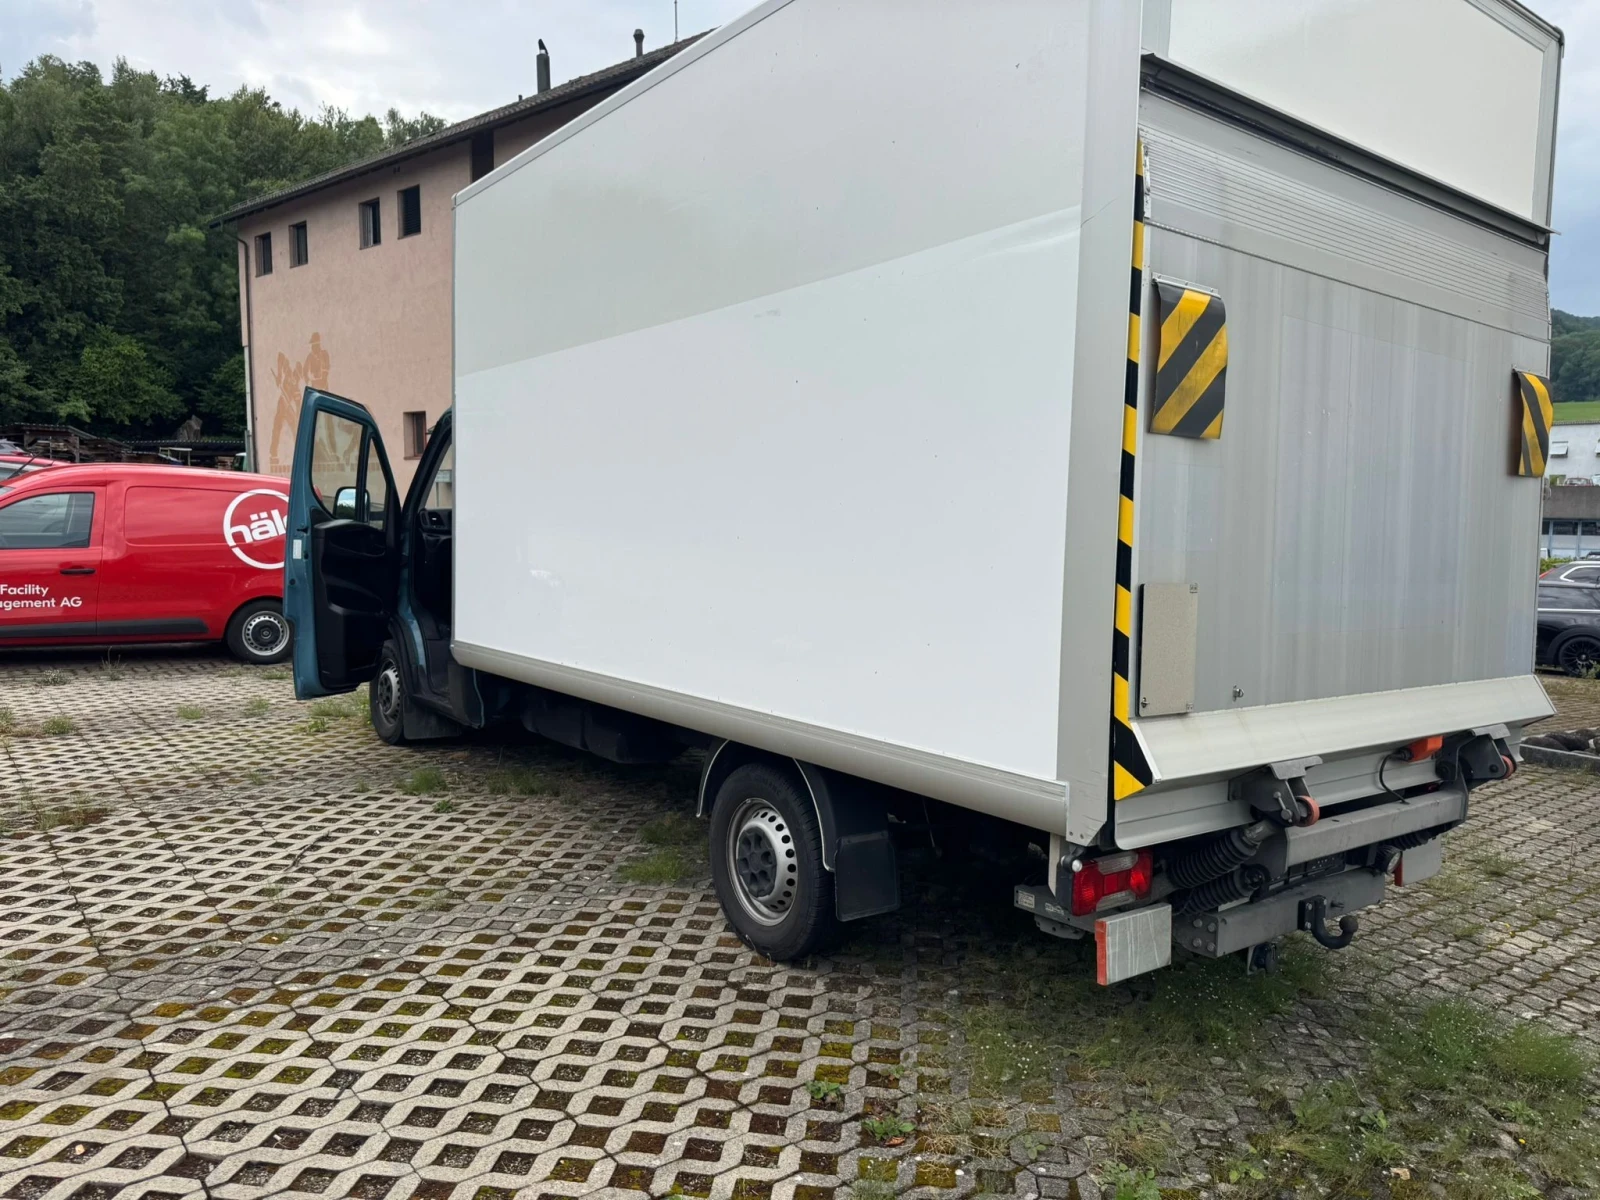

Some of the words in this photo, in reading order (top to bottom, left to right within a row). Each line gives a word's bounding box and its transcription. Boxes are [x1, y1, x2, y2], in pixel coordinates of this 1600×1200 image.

[224, 509, 287, 546] häl
[0, 584, 49, 597] Facility
[0, 598, 56, 611] gement
[60, 596, 82, 608] AG
